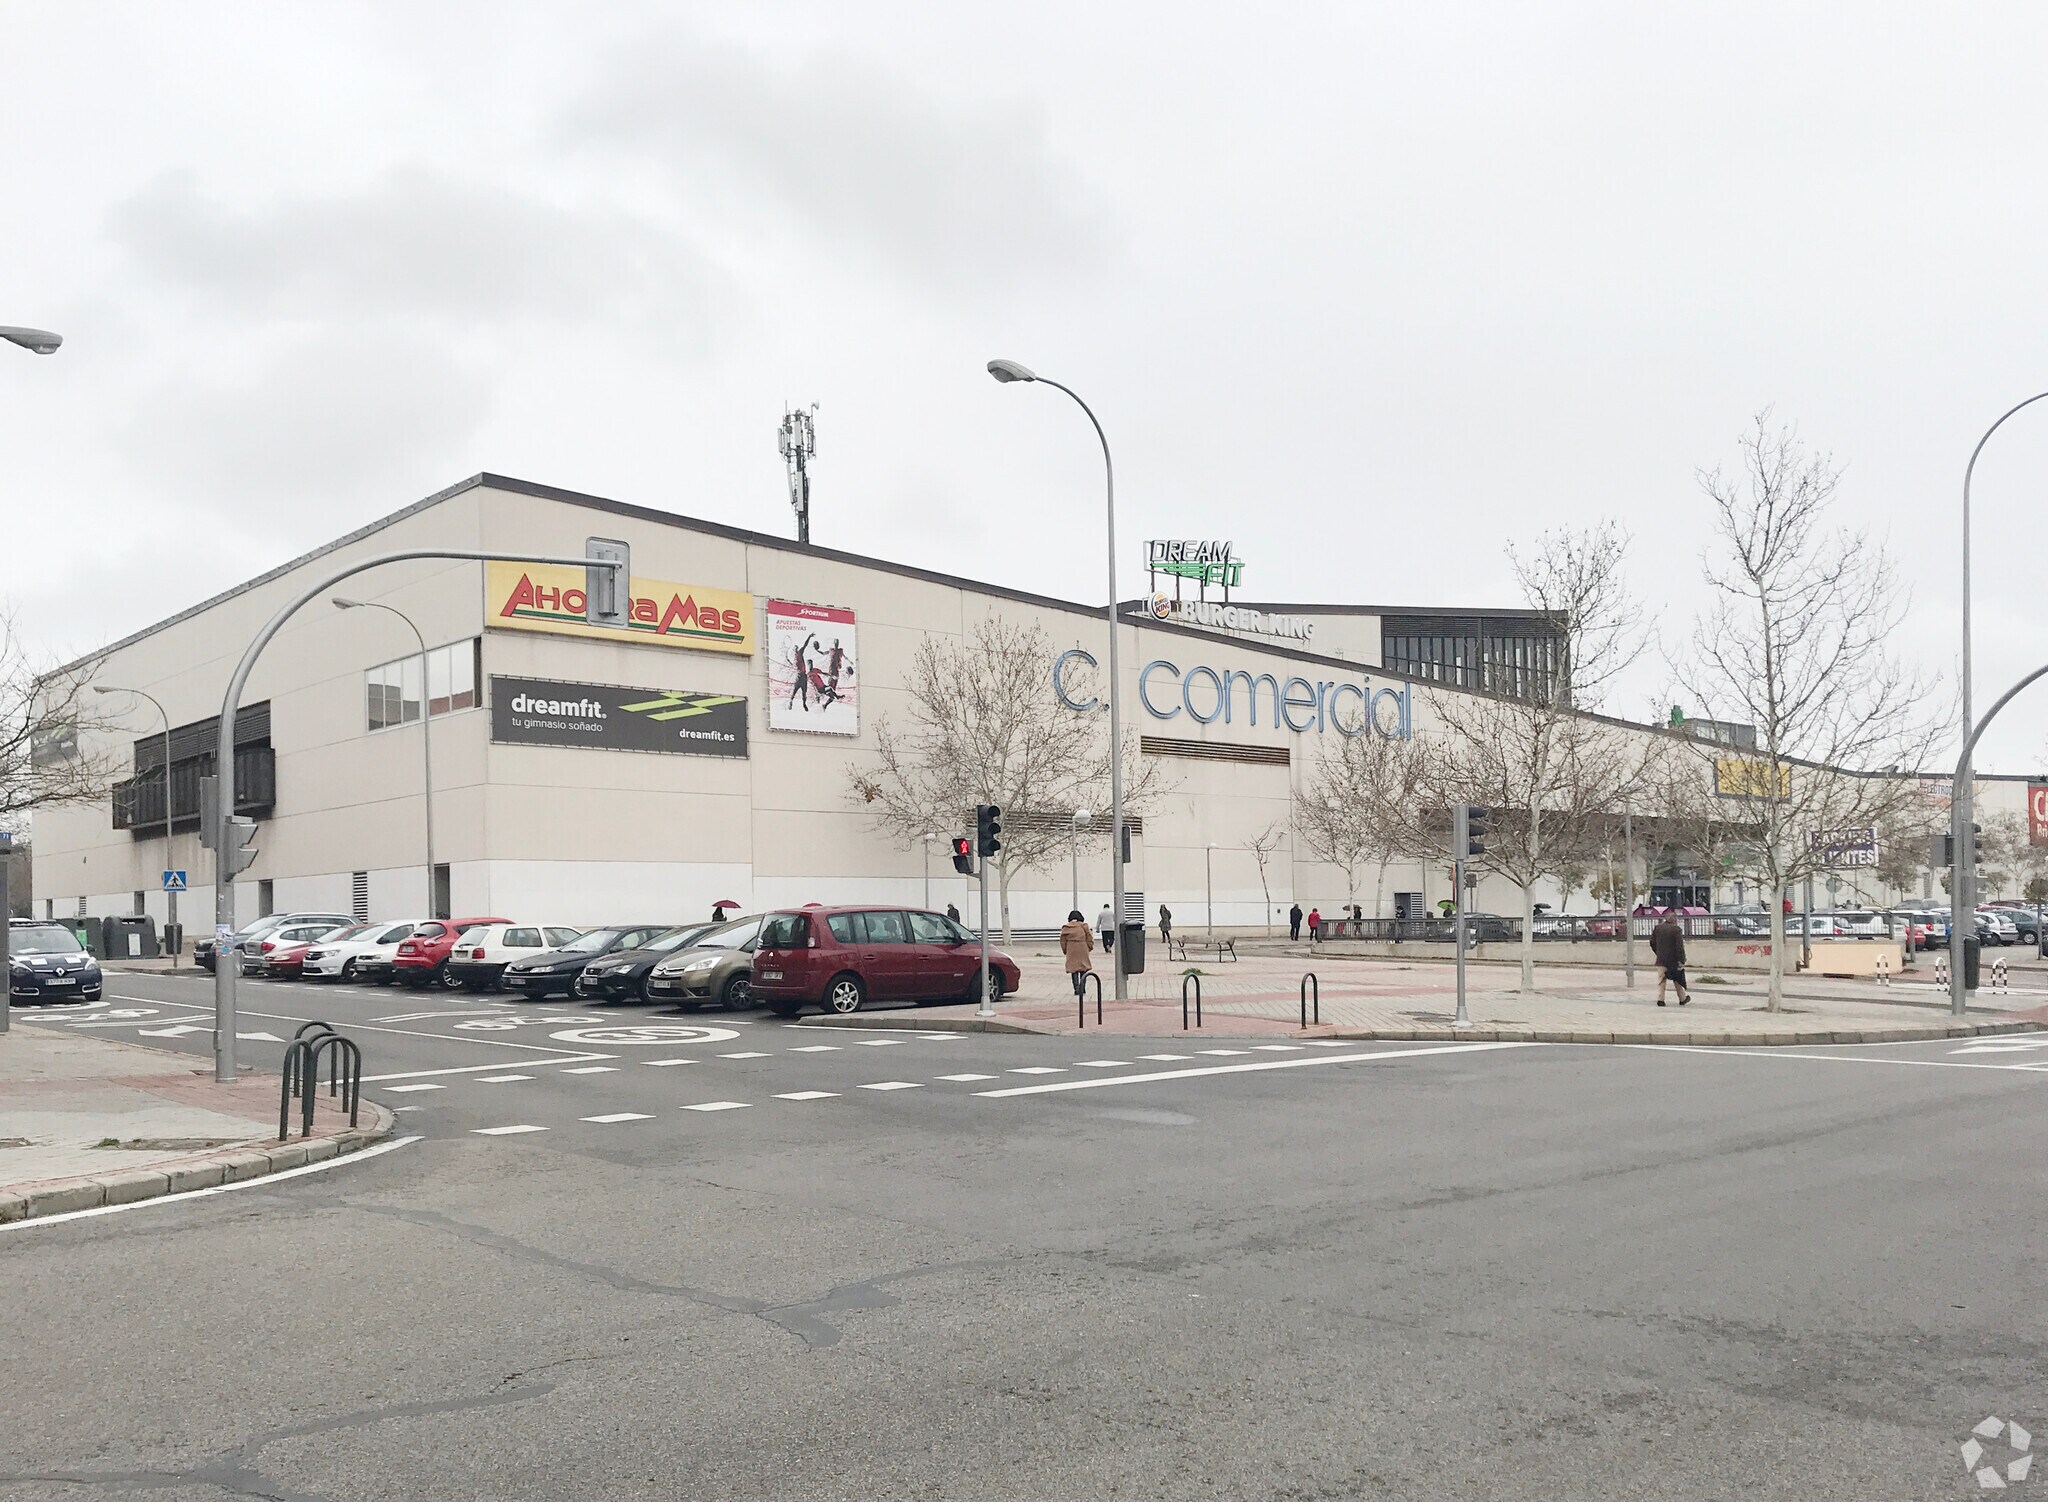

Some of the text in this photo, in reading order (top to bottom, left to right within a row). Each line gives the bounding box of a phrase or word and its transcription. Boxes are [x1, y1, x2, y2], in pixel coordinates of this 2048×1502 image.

[1151, 540, 1233, 561] DREAM
[1181, 601, 1315, 640] BURGER KING
[512, 717, 603, 732] tu gimnasio soñado
[679, 728, 735, 742] dreamfit.es
